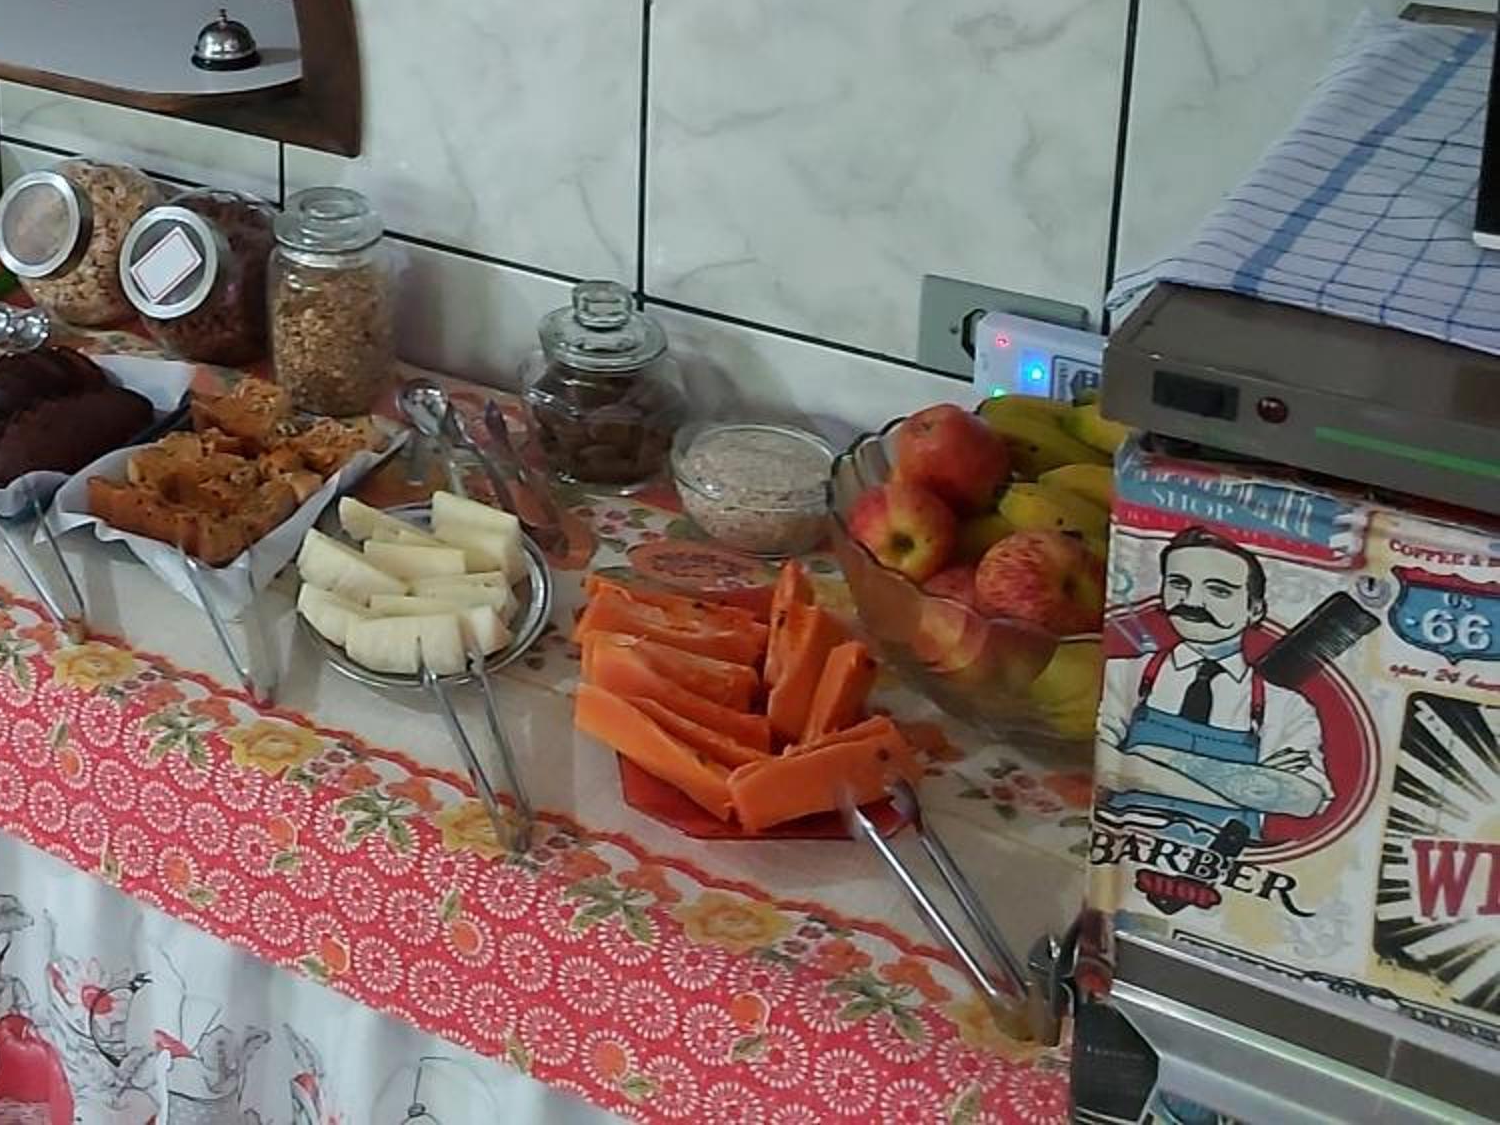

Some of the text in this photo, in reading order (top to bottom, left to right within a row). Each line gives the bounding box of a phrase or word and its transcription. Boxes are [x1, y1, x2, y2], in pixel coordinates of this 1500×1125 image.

[1150, 487, 1234, 521] SHOP
[1389, 538, 1466, 566] COFFEE
[1422, 607, 1492, 651] 66
[1090, 831, 1316, 918] BARBER
